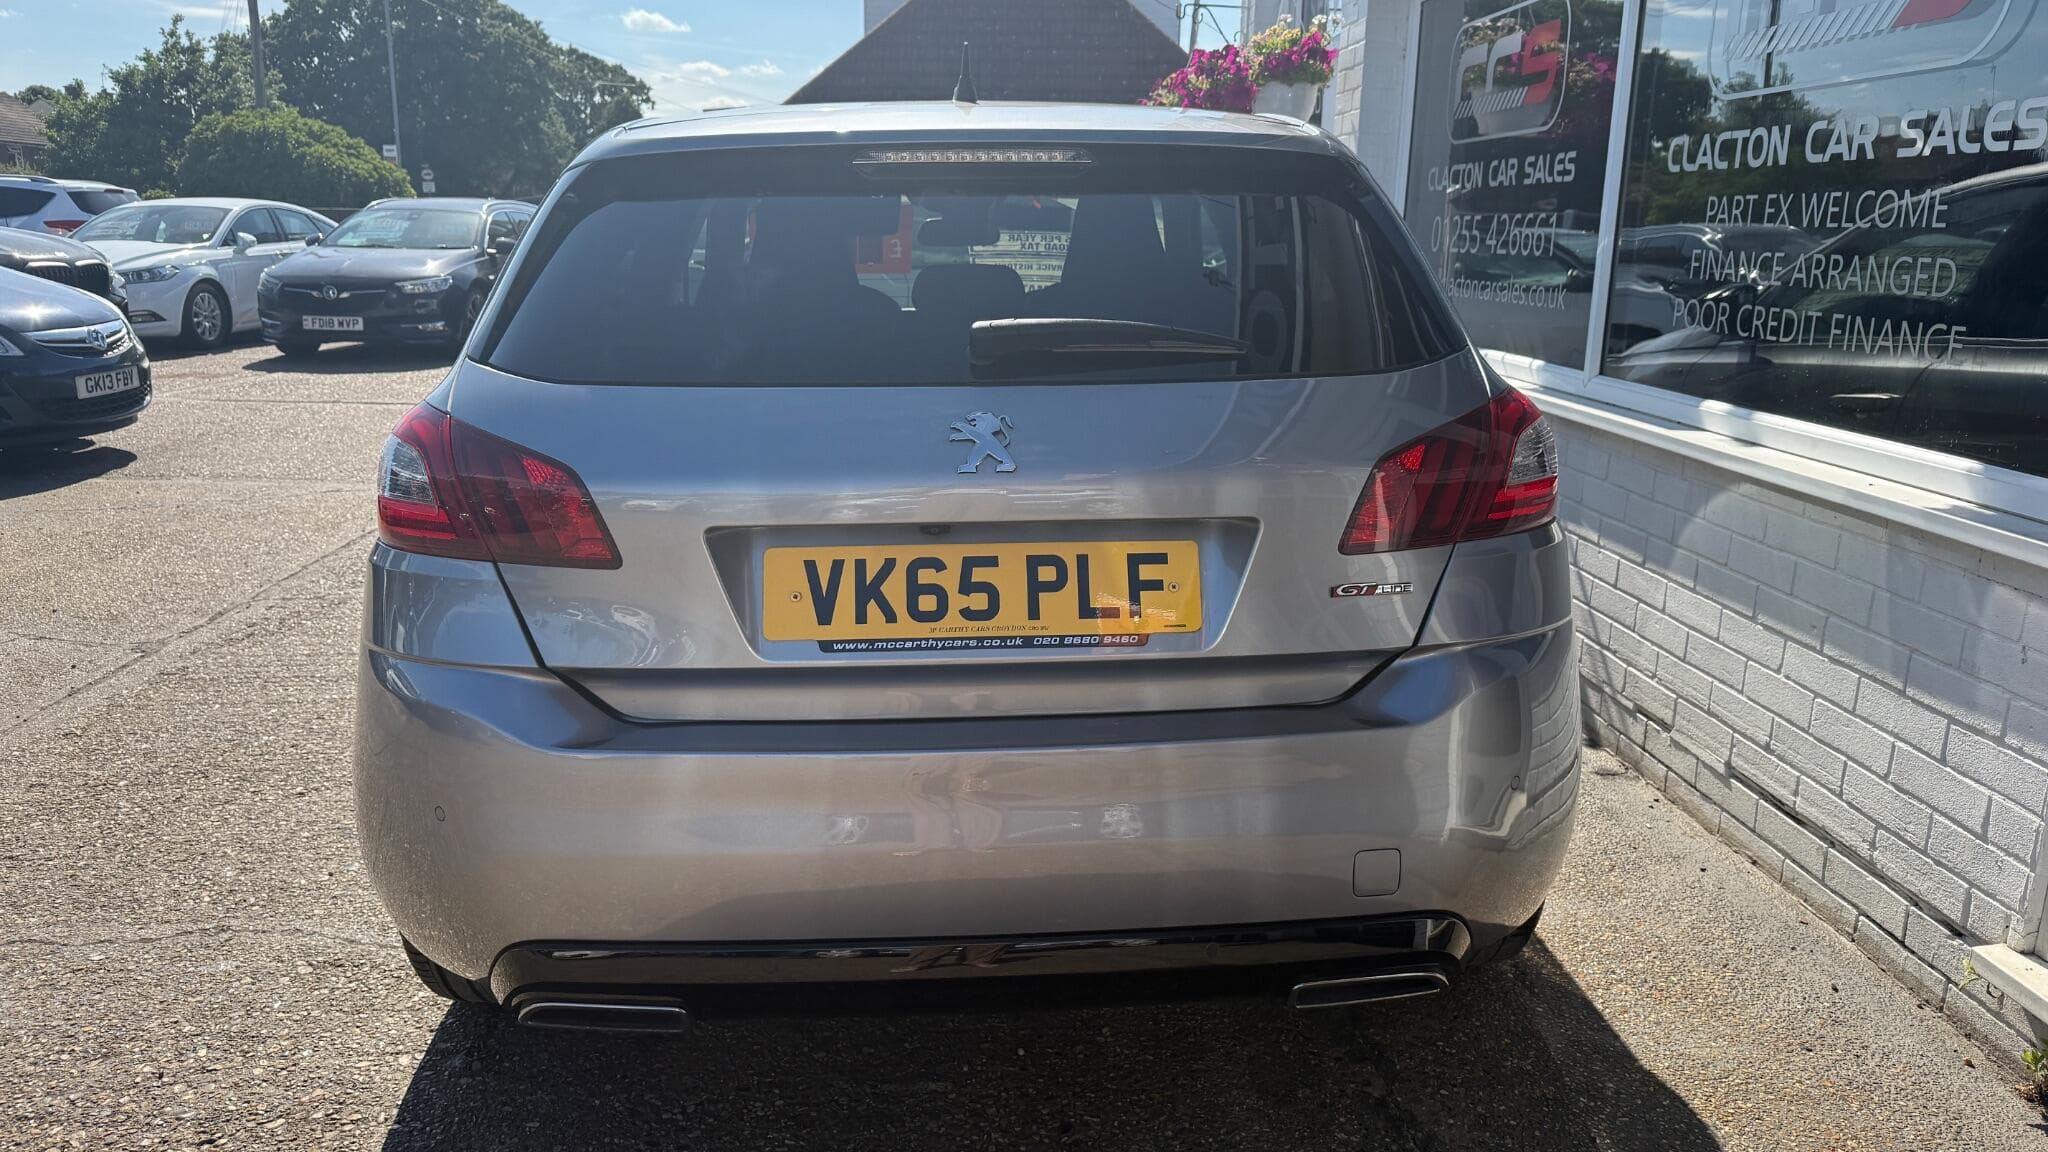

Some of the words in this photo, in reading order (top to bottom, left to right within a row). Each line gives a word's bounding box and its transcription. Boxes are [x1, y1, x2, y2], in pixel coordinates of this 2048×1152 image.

[1667, 124, 1792, 174] CLACTON
[1805, 115, 1881, 164] CAR
[1896, 96, 2048, 158] SALES
[1428, 161, 1484, 192] CLACTON
[1488, 157, 1518, 188] CAR
[1523, 150, 1577, 185] SALES
[1704, 194, 1761, 229] PART
[1762, 193, 1795, 228] EX
[1801, 187, 1952, 229] WELCOME
[1431, 214, 1482, 254] 01255
[1485, 211, 1558, 257] 426661
[1688, 249, 1786, 287] FINANCE
[1790, 253, 1958, 298] ARRANGED
[311, 317, 335, 328] FD18
[1673, 298, 1730, 335] POOR
[1736, 303, 1823, 346] CREDIT
[1828, 313, 1967, 363] FINANCE
[85, 374, 115, 394] GK13
[115, 369, 136, 389] FBY
[803, 556, 1001, 626] VK65
[1026, 552, 1170, 621] PLF
[1336, 582, 1376, 596] GT
[832, 636, 1024, 650] www.mccarthycars.co.uk
[1033, 637, 1060, 646] 020
[1063, 636, 1100, 645] 8680
